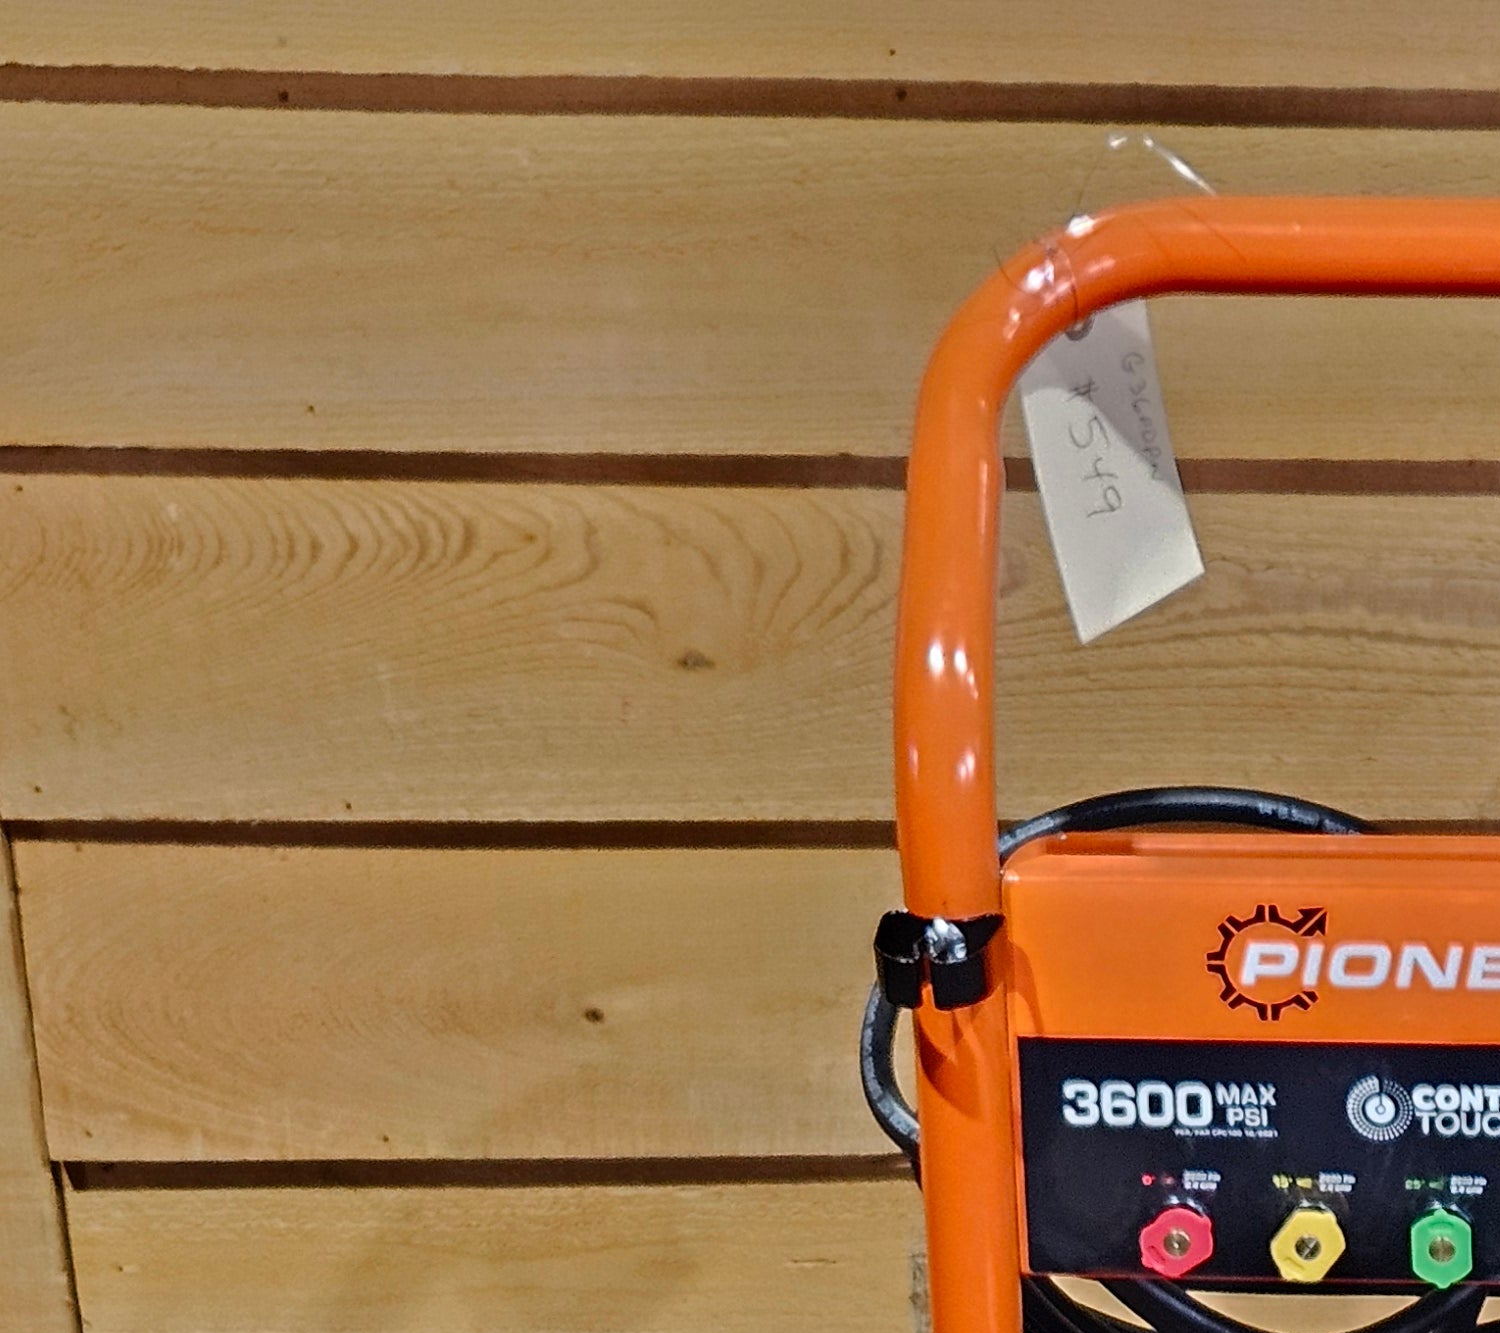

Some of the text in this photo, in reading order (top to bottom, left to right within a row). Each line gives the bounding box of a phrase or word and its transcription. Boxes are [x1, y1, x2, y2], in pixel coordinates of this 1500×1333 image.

[1062, 1078, 1213, 1127] 3600
[1215, 1082, 1277, 1106] MAX
[1226, 1107, 1268, 1127] PSI
